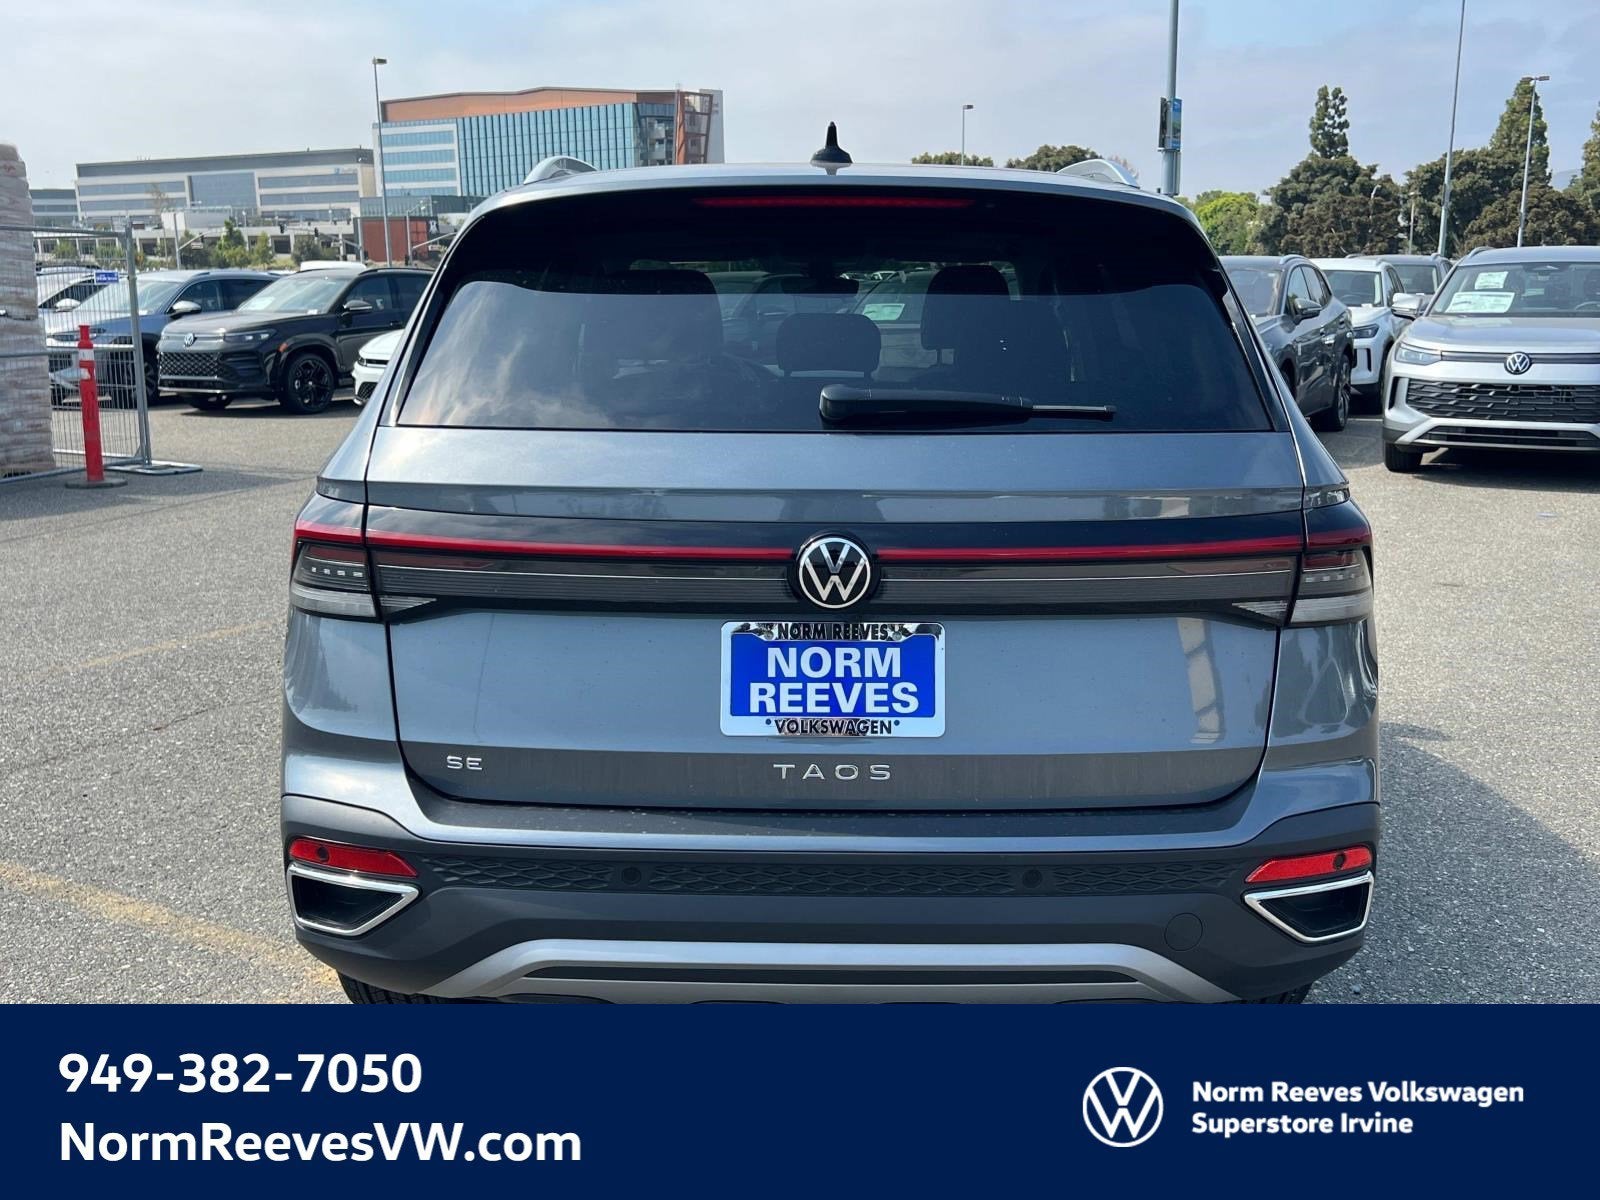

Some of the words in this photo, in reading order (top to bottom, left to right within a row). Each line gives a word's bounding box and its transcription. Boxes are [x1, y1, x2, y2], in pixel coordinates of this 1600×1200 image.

[1506, 353, 1530, 374] VW
[799, 538, 871, 609] VW
[777, 622, 827, 640] NORM
[832, 623, 888, 640] REEVES
[767, 646, 901, 678] NORM
[750, 682, 919, 714] REEVES
[775, 718, 892, 735] VOLKSWAGEN
[446, 755, 482, 770] SE
[773, 763, 891, 780] TAOS
